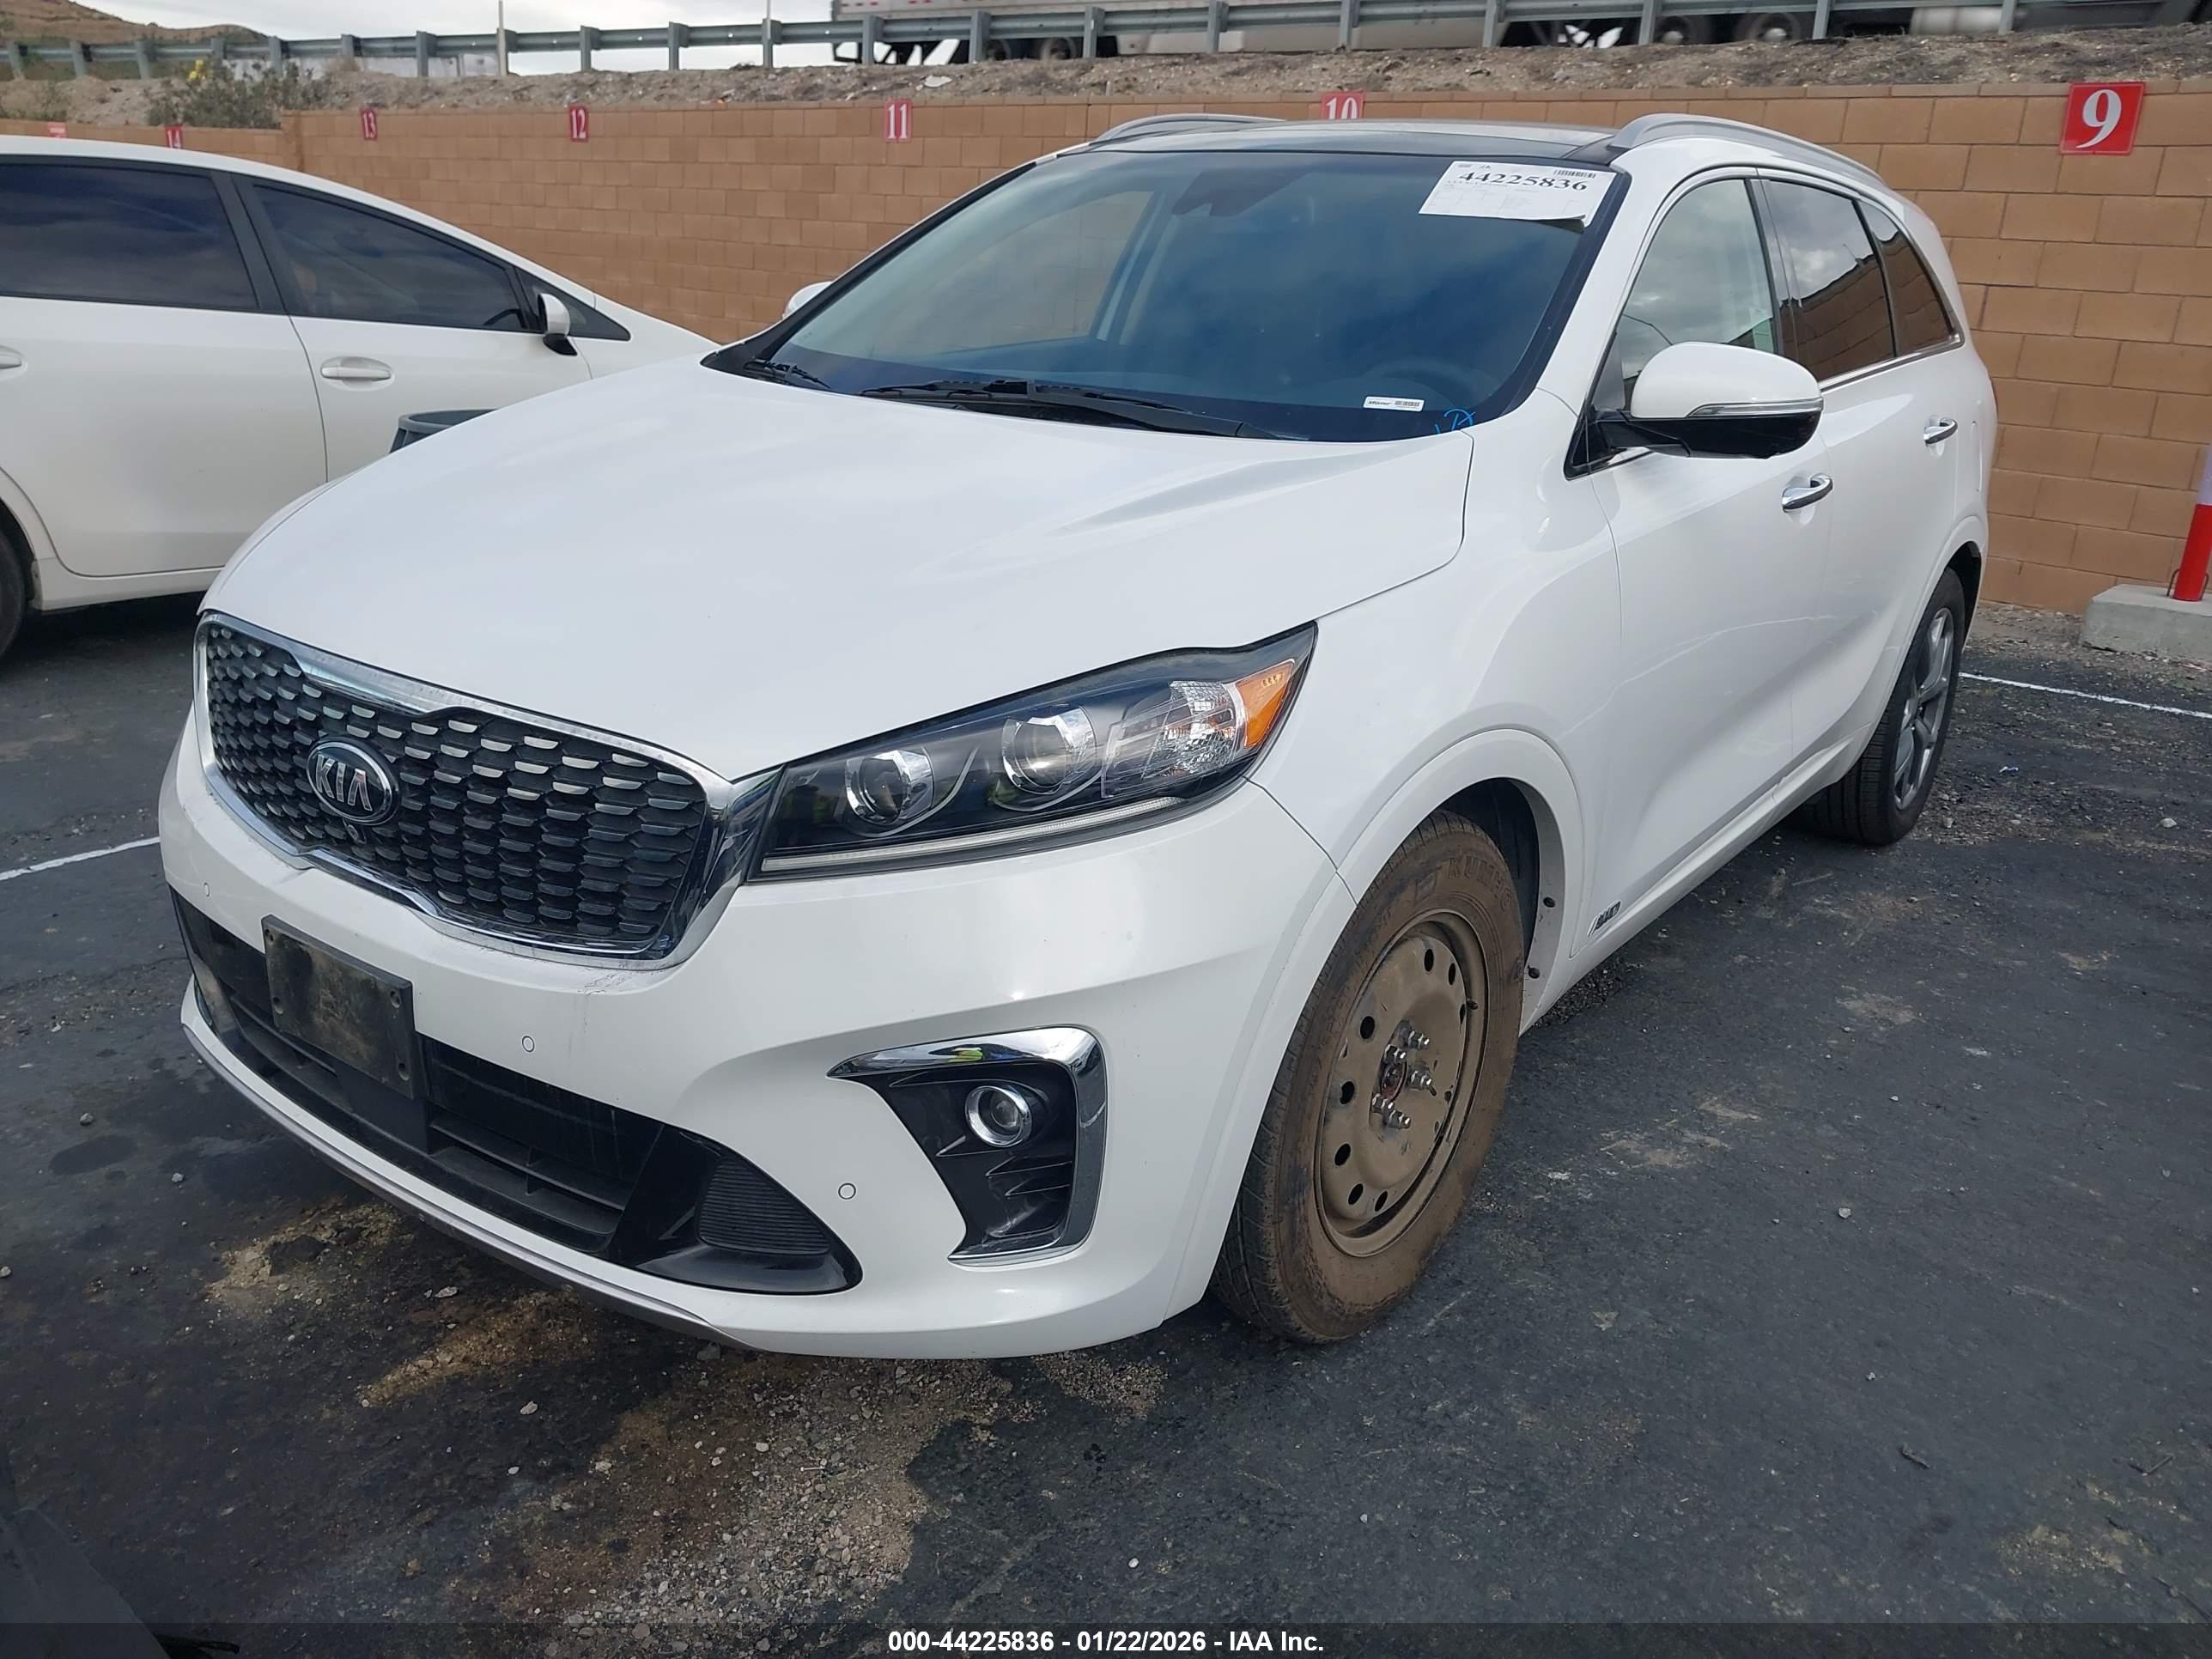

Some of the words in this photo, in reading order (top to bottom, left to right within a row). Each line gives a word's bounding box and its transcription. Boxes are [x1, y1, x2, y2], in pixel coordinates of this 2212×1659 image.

[887, 103, 908, 139] 11
[1325, 96, 1358, 119] 10
[2075, 88, 2122, 149] 9
[362, 112, 376, 138] 13
[570, 109, 586, 139] 12
[1459, 170, 1588, 191] 44225836
[315, 754, 373, 811] KIA
